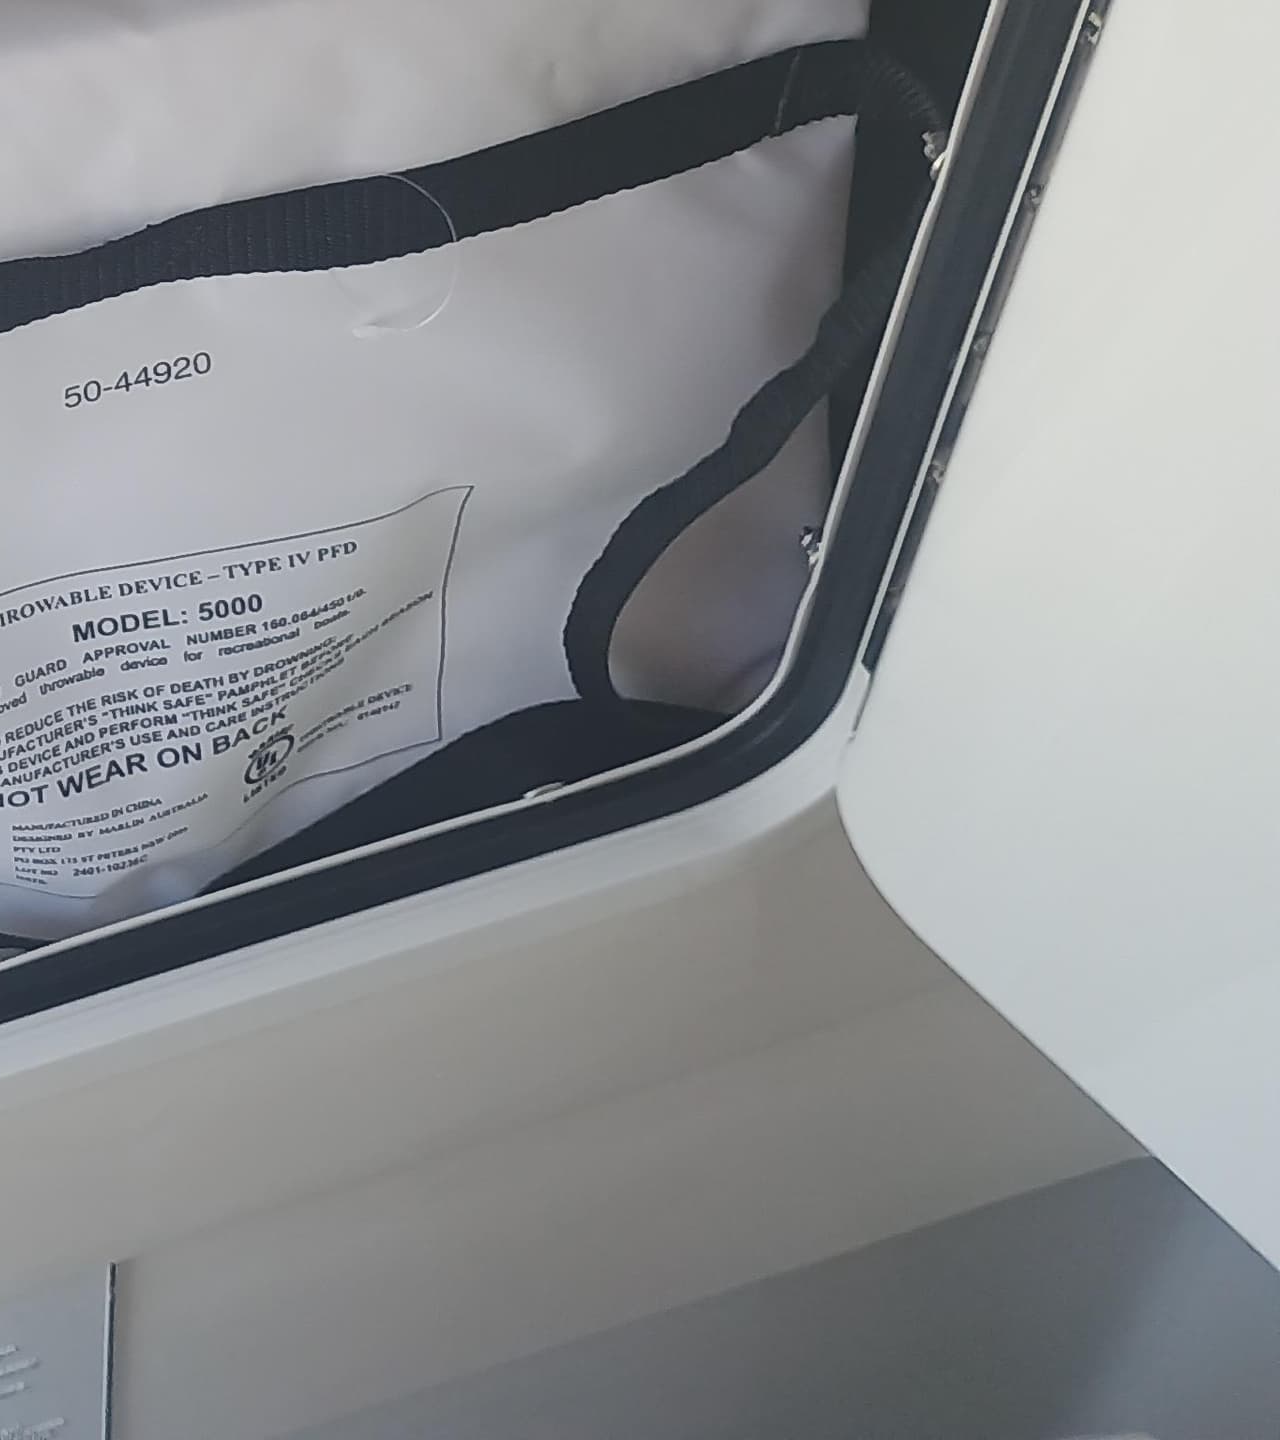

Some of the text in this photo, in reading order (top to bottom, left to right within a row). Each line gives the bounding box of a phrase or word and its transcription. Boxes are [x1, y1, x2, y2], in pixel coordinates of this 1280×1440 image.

[64, 351, 212, 408] 50-44920
[118, 569, 203, 599] DEVICE
[223, 556, 282, 580] TYPE
[288, 552, 310, 568] IV
[318, 541, 358, 562] PFD
[72, 594, 263, 643] MODEL: 5000
[14, 659, 68, 688] GUARD
[82, 638, 171, 664] APPROVAL
[186, 624, 257, 646] NUMBER
[40, 666, 105, 696] throwable
[120, 654, 168, 672] device
[184, 647, 203, 662] for
[218, 627, 301, 657] recreational
[217, 667, 297, 700] PAMPHLET
[4, 710, 64, 744] REDUCE
[66, 696, 97, 718] THE
[100, 689, 138, 707] RISK
[144, 684, 166, 698] OF
[169, 677, 224, 694] DEATH
[228, 670, 251, 685] BY
[130, 732, 163, 746] USE
[167, 725, 201, 741] AND
[205, 713, 247, 733] CARE
[8, 747, 61, 773] DEVICE
[64, 731, 96, 756] AND
[98, 713, 178, 738] PERFORM
[56, 752, 147, 798] WEAR
[157, 742, 203, 770] ON
[212, 705, 289, 756] BACK
